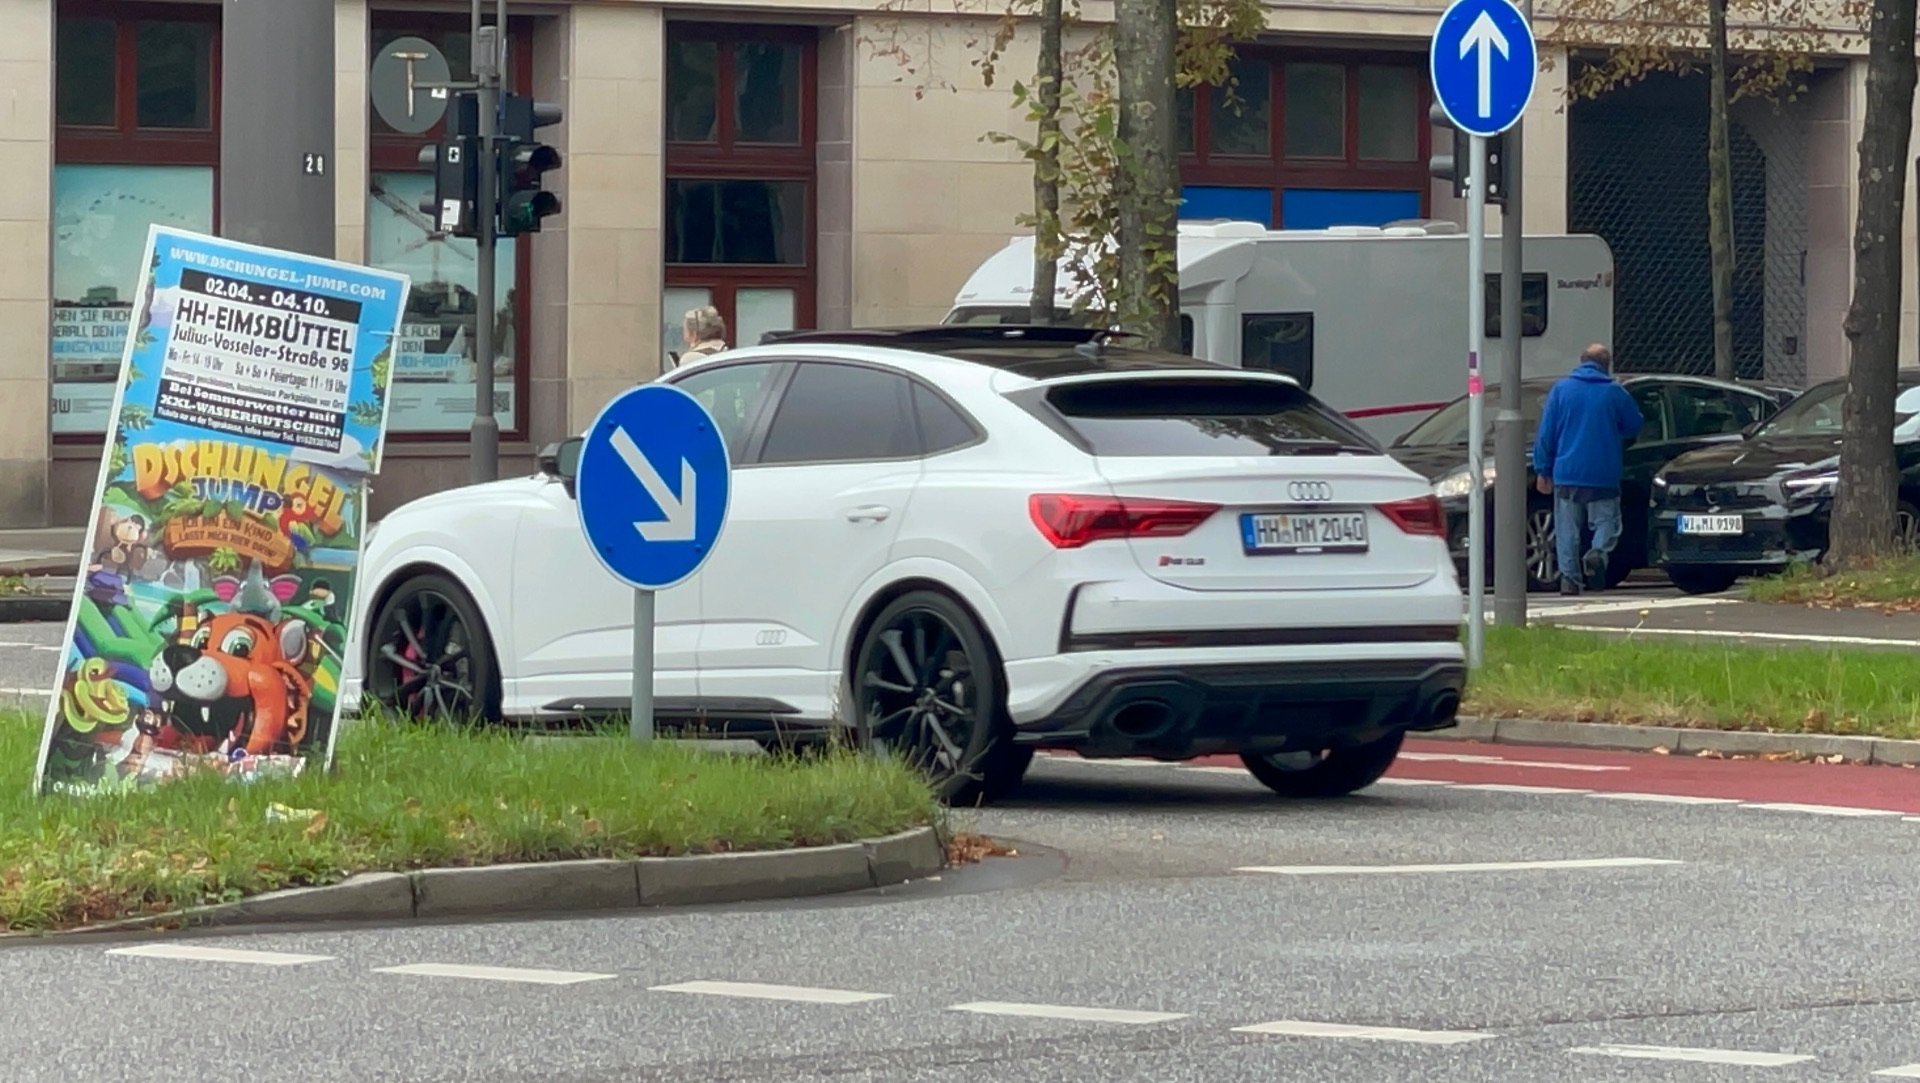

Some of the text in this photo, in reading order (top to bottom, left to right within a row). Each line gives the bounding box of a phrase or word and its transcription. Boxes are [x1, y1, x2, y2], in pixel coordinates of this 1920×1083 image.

[170, 247, 386, 300] WWW.DSCHUNGEL-JUMP.COM
[205, 277, 253, 302] 02.04.
[271, 290, 330, 315] 04.10.
[176, 298, 352, 354] HH-EIMSBÜTTEL
[172, 323, 349, 373] Julius-Vosseler-Straße 98
[235, 361, 244, 376] Sa
[251, 364, 262, 379] So
[310, 375, 319, 389] 11
[325, 378, 334, 391] 19
[334, 378, 347, 394] Uhr
[160, 394, 341, 439] XXL-WASSERRUTSCHEN!
[169, 381, 337, 423] Bei Sommerwetter mit
[133, 440, 346, 536] DSCHUNGEL
[191, 477, 283, 514] JUMP
[222, 517, 241, 531] EIN
[1256, 517, 1363, 543] HH HM 2040
